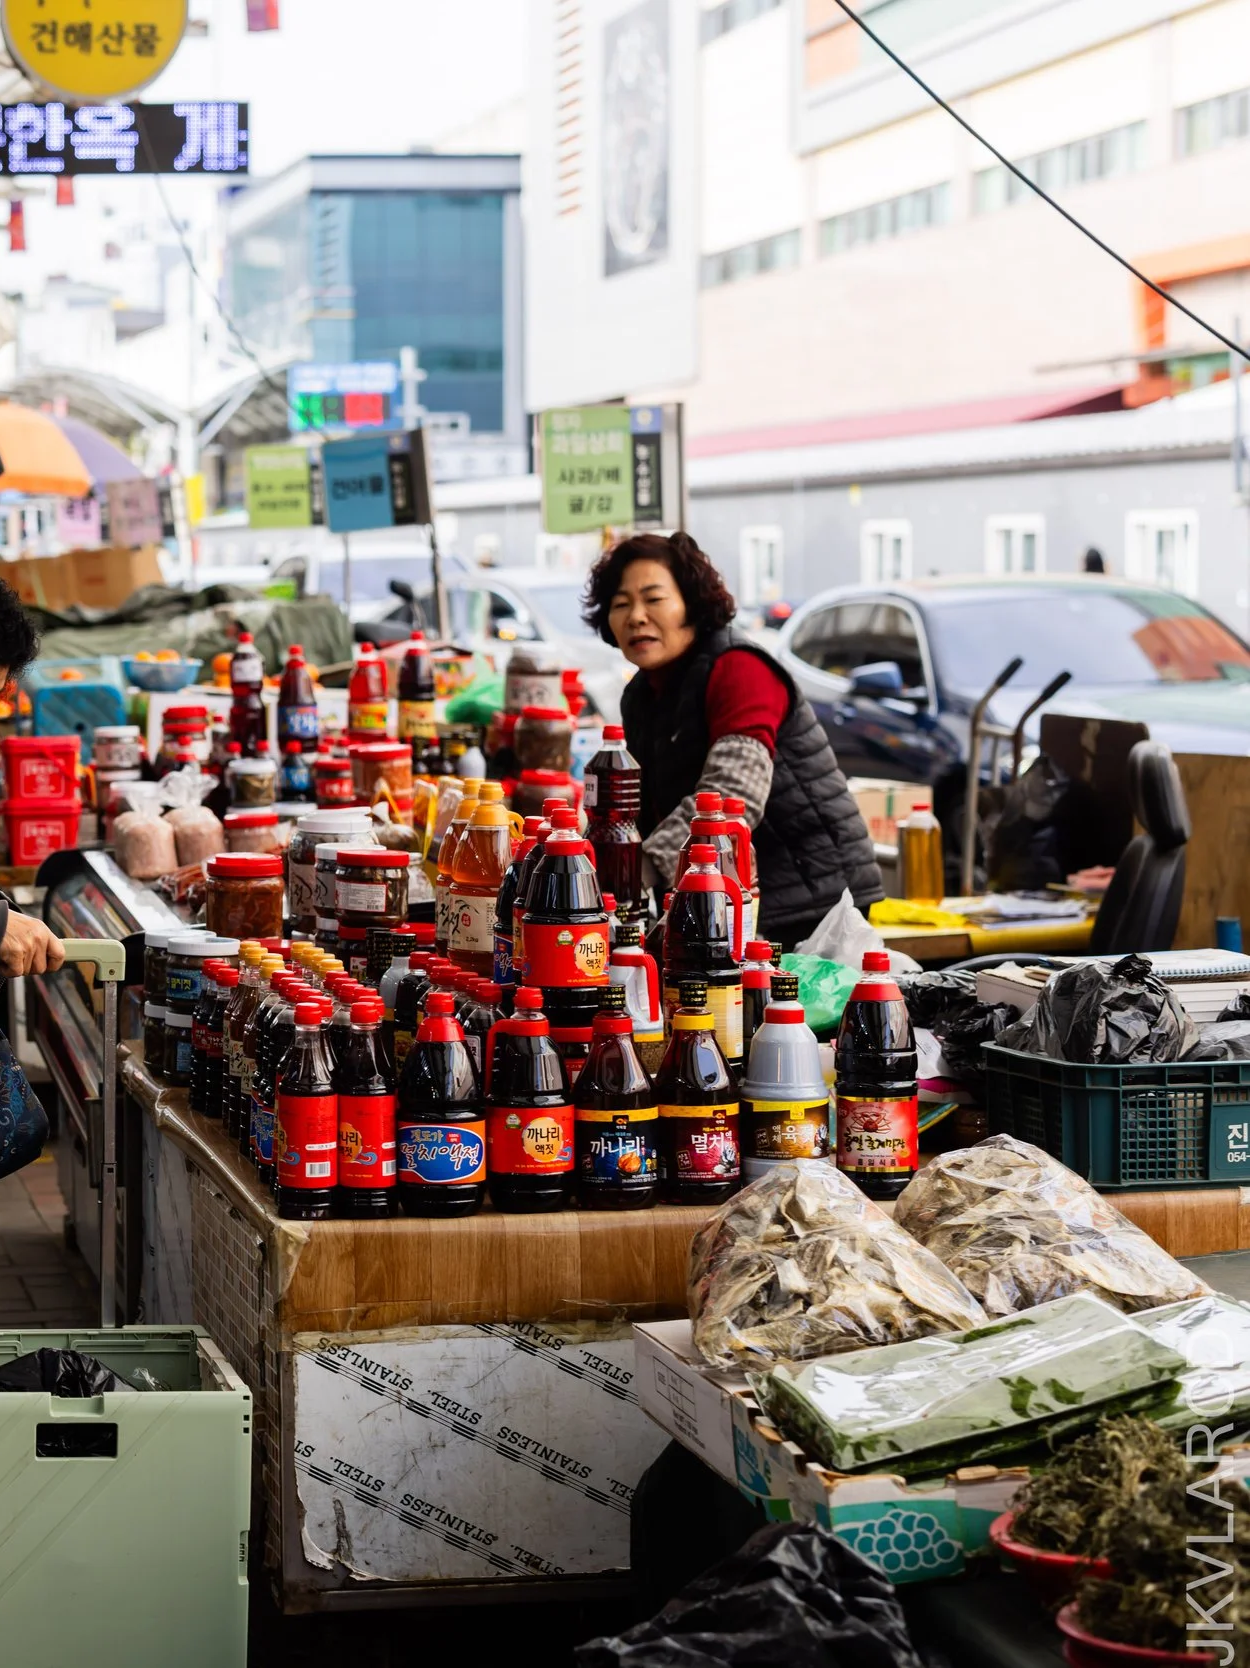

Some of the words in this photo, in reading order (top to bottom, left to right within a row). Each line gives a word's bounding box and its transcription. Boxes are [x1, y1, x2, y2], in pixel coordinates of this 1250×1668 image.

[31, 20, 161, 57] 건해산물
[579, 942, 606, 958] 까나리
[586, 958, 601, 970] 액젓
[527, 1126, 561, 1143] 까나리
[590, 1135, 641, 1158] 까나리
[691, 1131, 725, 1154] 멸치
[1227, 1123, 1249, 1150] 진
[400, 1143, 480, 1171] 멸치액젓
[535, 1143, 554, 1155] 액젓
[1227, 1152, 1250, 1163] 054-
[508, 1321, 566, 1351] STAIN
[317, 1337, 414, 1391] STAINLESS
[579, 1349, 634, 1385] STEEL.
[427, 1389, 483, 1425] STEEL.
[497, 1425, 592, 1479] STAINLESS
[329, 1456, 386, 1492] STEEL.
[399, 1493, 496, 1547] STAINLESS
